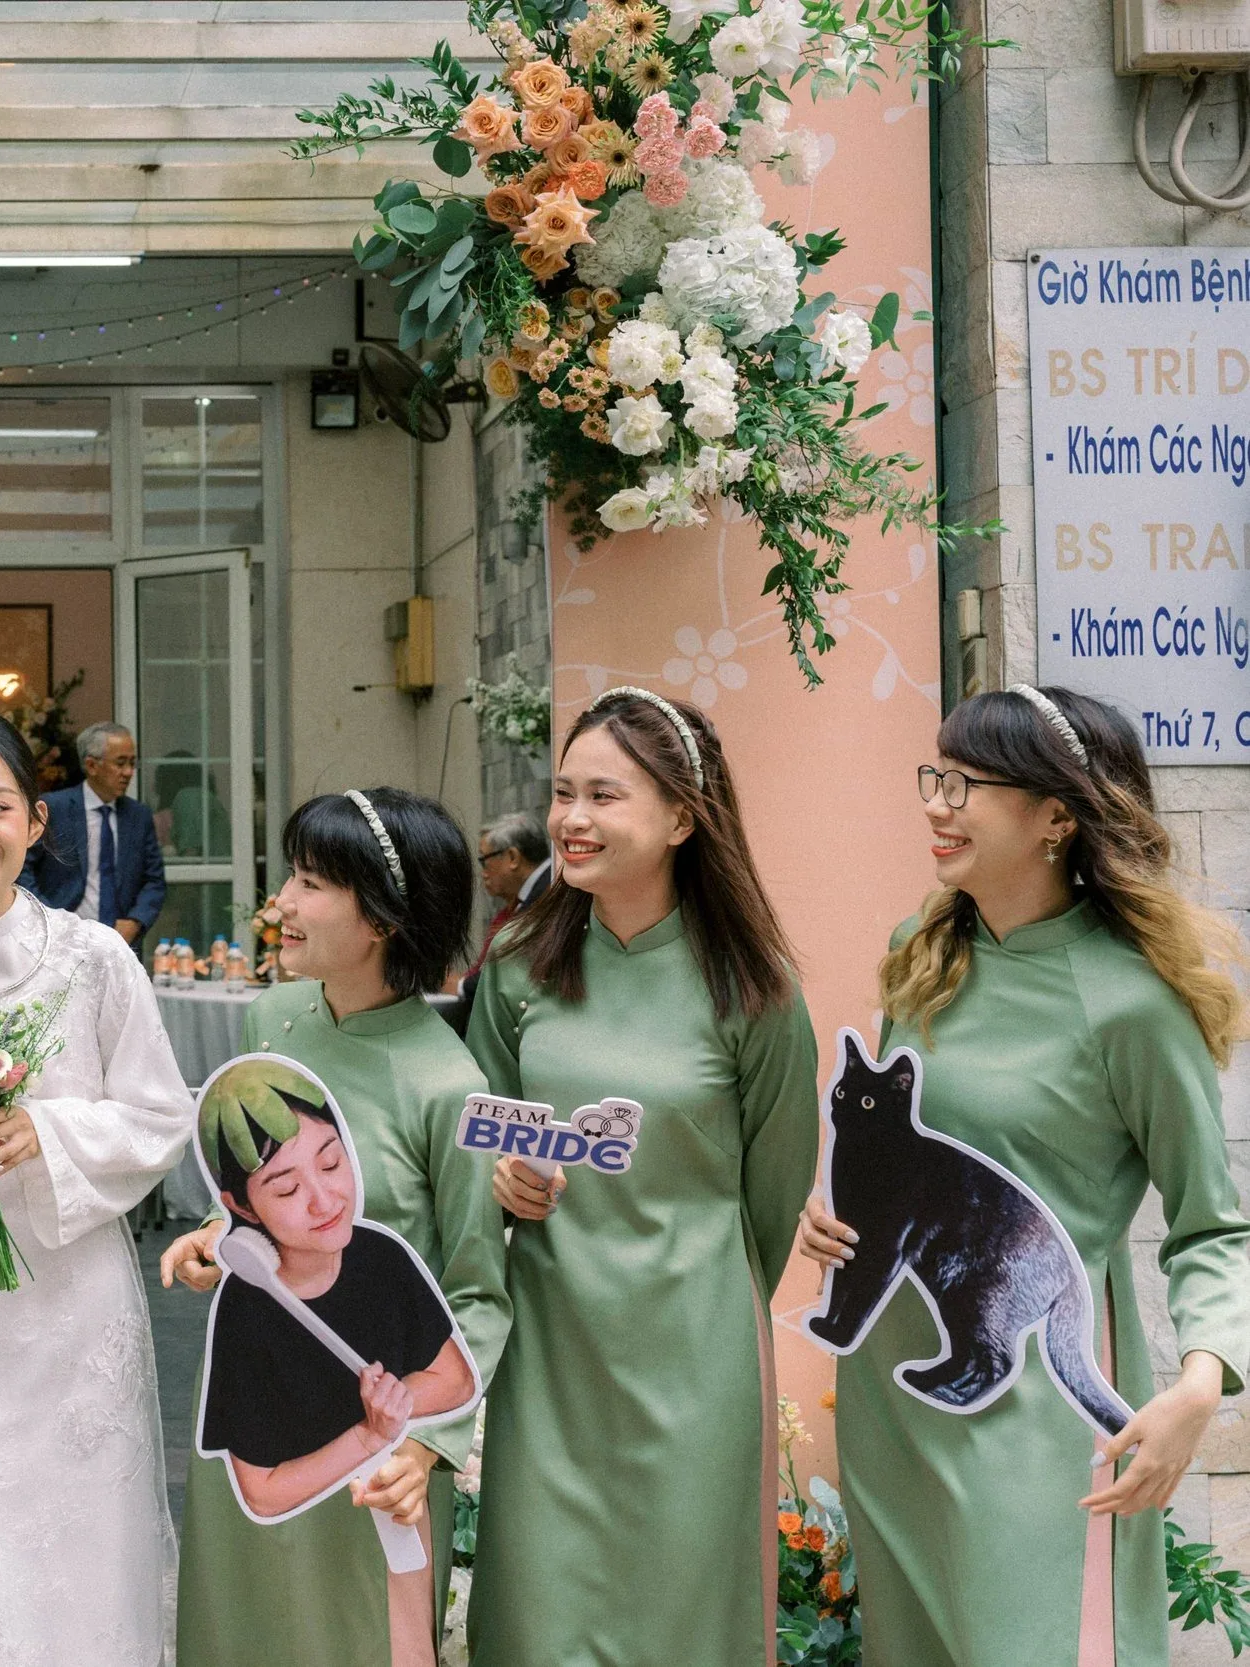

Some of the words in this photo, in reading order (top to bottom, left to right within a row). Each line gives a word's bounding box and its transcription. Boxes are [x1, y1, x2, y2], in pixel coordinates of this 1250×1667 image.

[1099, 258, 1181, 304] Khám
[1047, 348, 1108, 398] BS
[1127, 330, 1196, 396] TRÍ
[1068, 426, 1141, 475] Khám
[1149, 423, 1202, 474] Các
[1211, 423, 1250, 488] Ng
[1056, 523, 1115, 572] BS
[1141, 522, 1250, 572] TRA
[1071, 607, 1144, 657] Khám
[1152, 605, 1206, 657] Các
[1142, 708, 1192, 747] Thứ
[1202, 711, 1220, 752] 7,
[473, 1101, 548, 1126] TEAM
[463, 1116, 632, 1171] BRIDE
